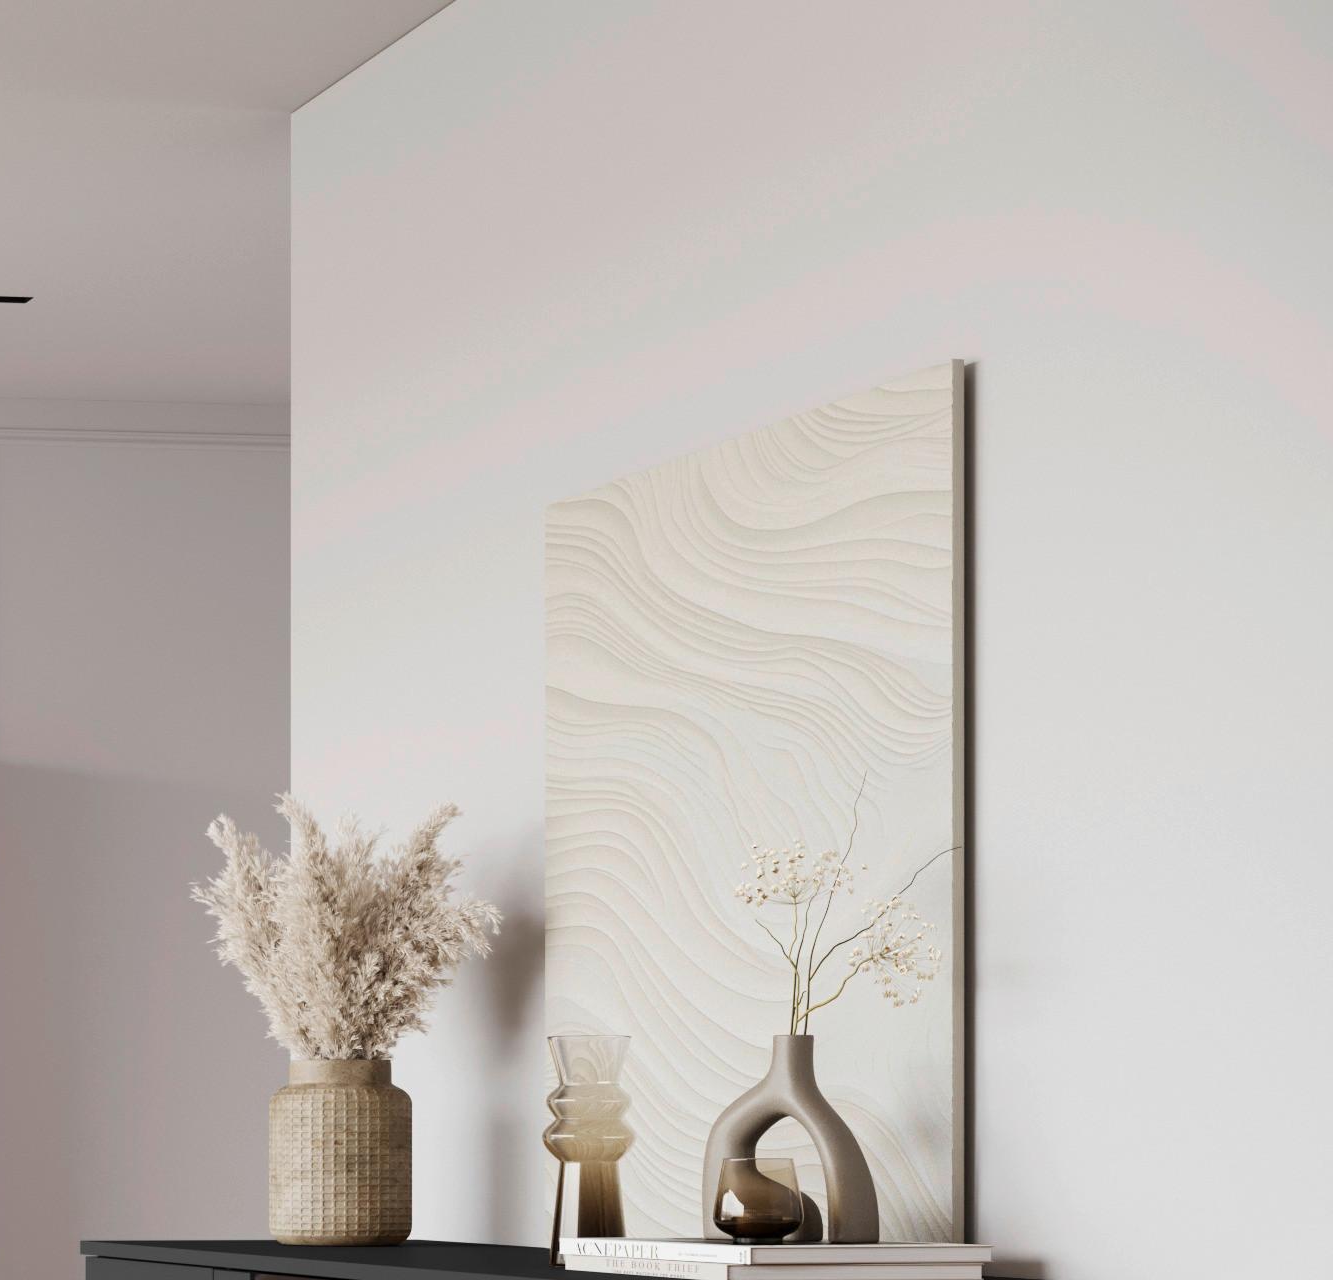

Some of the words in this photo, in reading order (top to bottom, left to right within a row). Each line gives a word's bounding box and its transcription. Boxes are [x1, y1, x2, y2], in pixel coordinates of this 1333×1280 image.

[605, 1258, 628, 1268] THE
[631, 1260, 661, 1271] BOOK
[667, 1263, 700, 1274] THIEF
